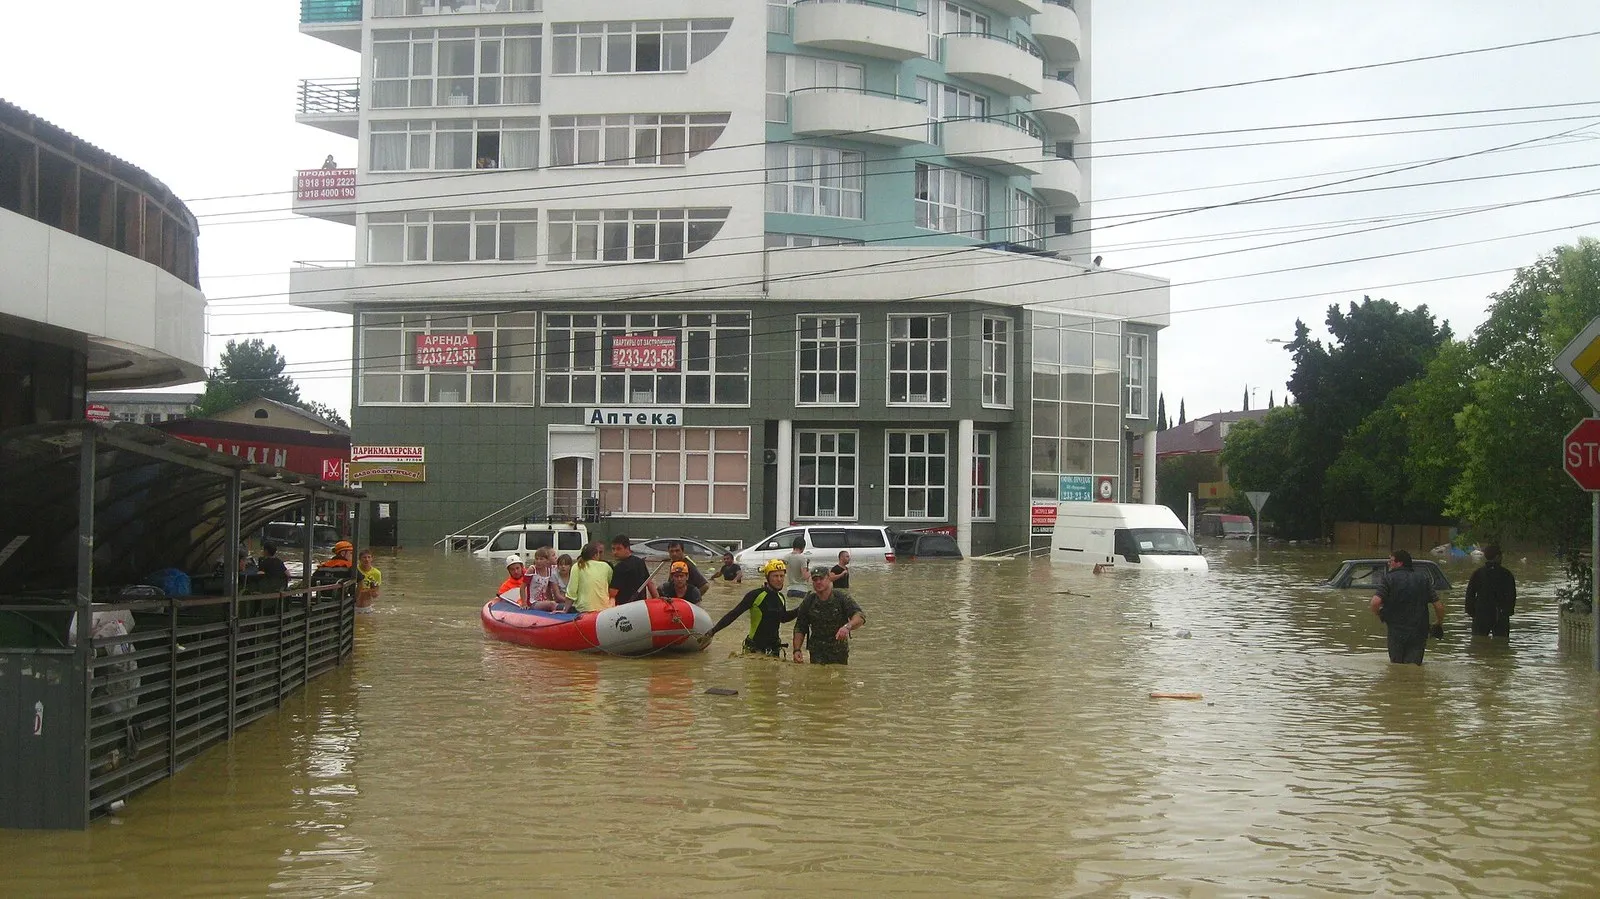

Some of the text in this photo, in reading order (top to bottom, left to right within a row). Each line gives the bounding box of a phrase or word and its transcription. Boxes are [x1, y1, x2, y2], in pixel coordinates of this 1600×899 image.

[305, 179, 320, 188] 918
[322, 178, 335, 187] 199
[336, 178, 355, 186] 2222
[305, 190, 319, 198] 918
[321, 188, 339, 198] 4000
[341, 187, 355, 197] 190
[424, 335, 469, 346] АРЕНДА
[613, 338, 636, 347] КВАРТИРЫ
[637, 338, 643, 347] ОТ
[422, 346, 476, 365] 233-23-58
[618, 348, 675, 367] 233-23-58
[590, 409, 677, 425] Аптека
[353, 446, 422, 455] ПАРИКМАХЕРСКАЯ
[1568, 442, 1600, 467] ST
